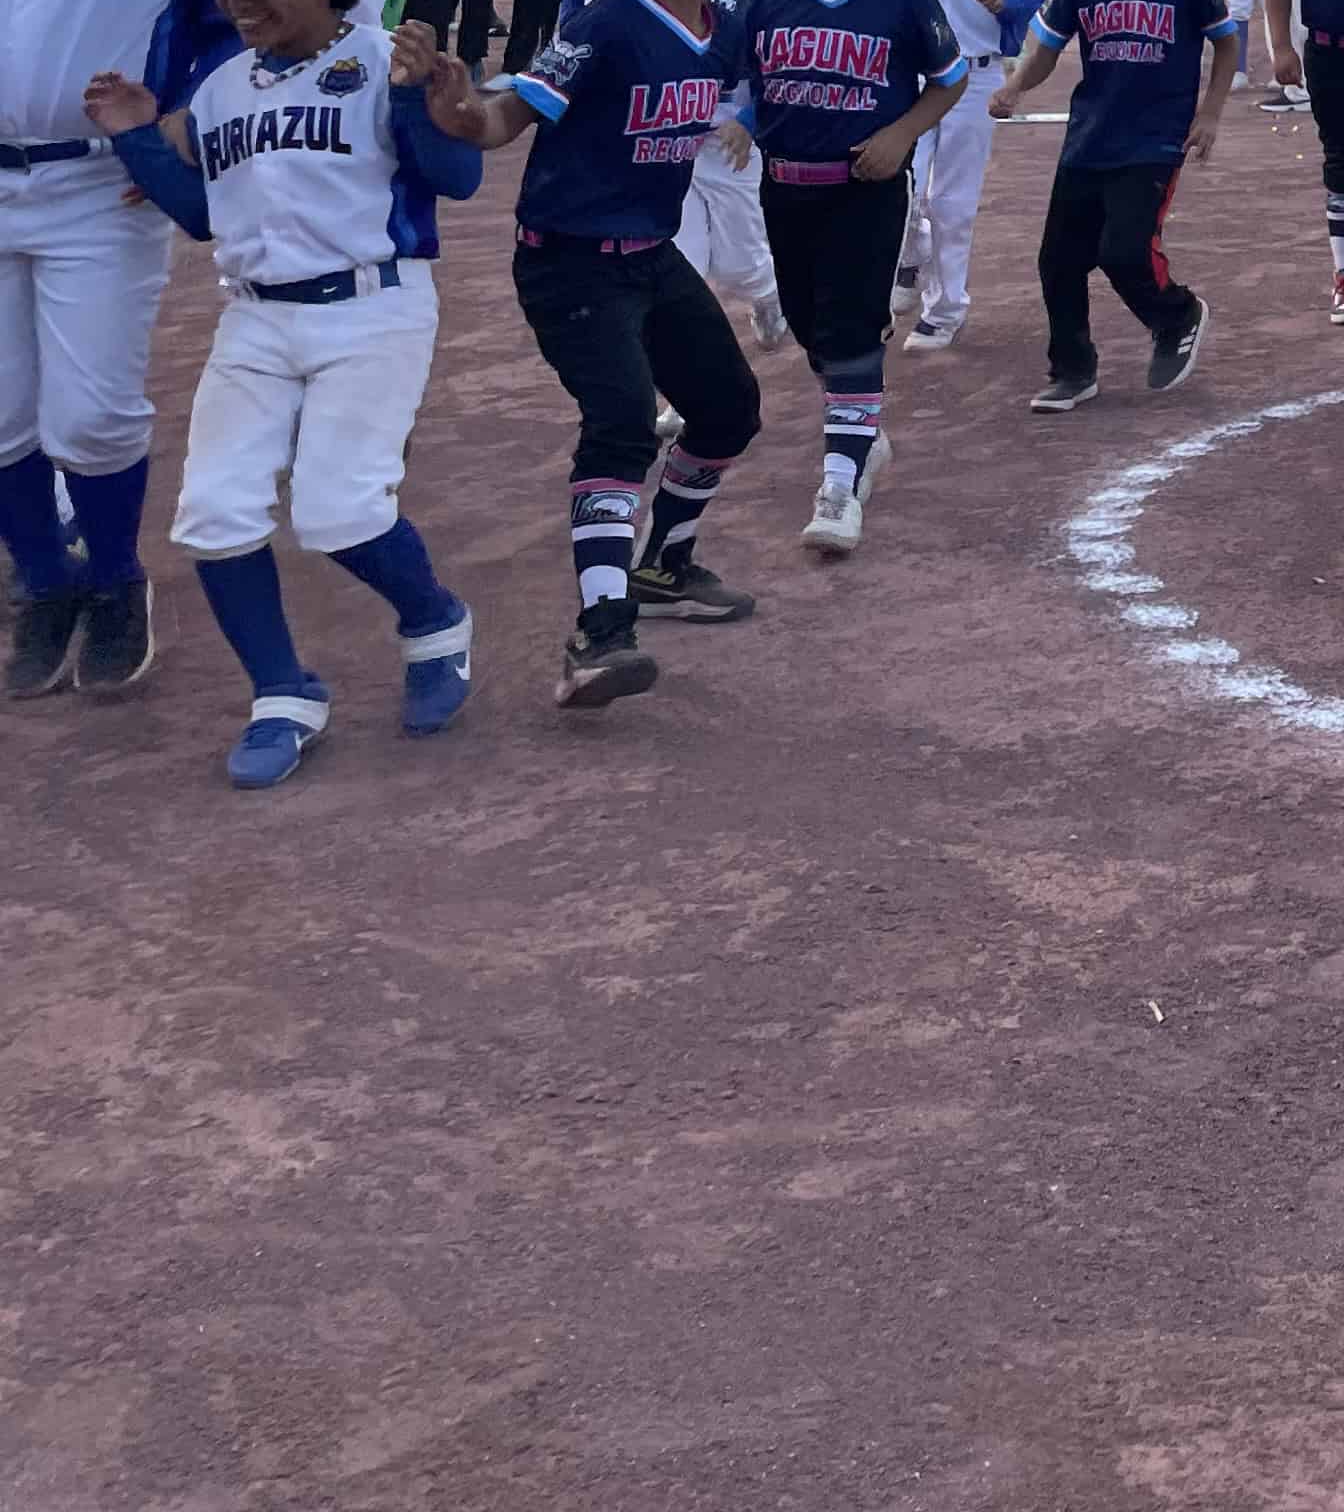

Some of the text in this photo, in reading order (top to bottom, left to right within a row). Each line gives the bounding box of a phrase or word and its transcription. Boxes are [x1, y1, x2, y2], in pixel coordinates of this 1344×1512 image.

[1079, 0, 1176, 44] LAGUNA
[755, 26, 892, 87] LAGUNA
[202, 105, 353, 181] FURIAZUL
